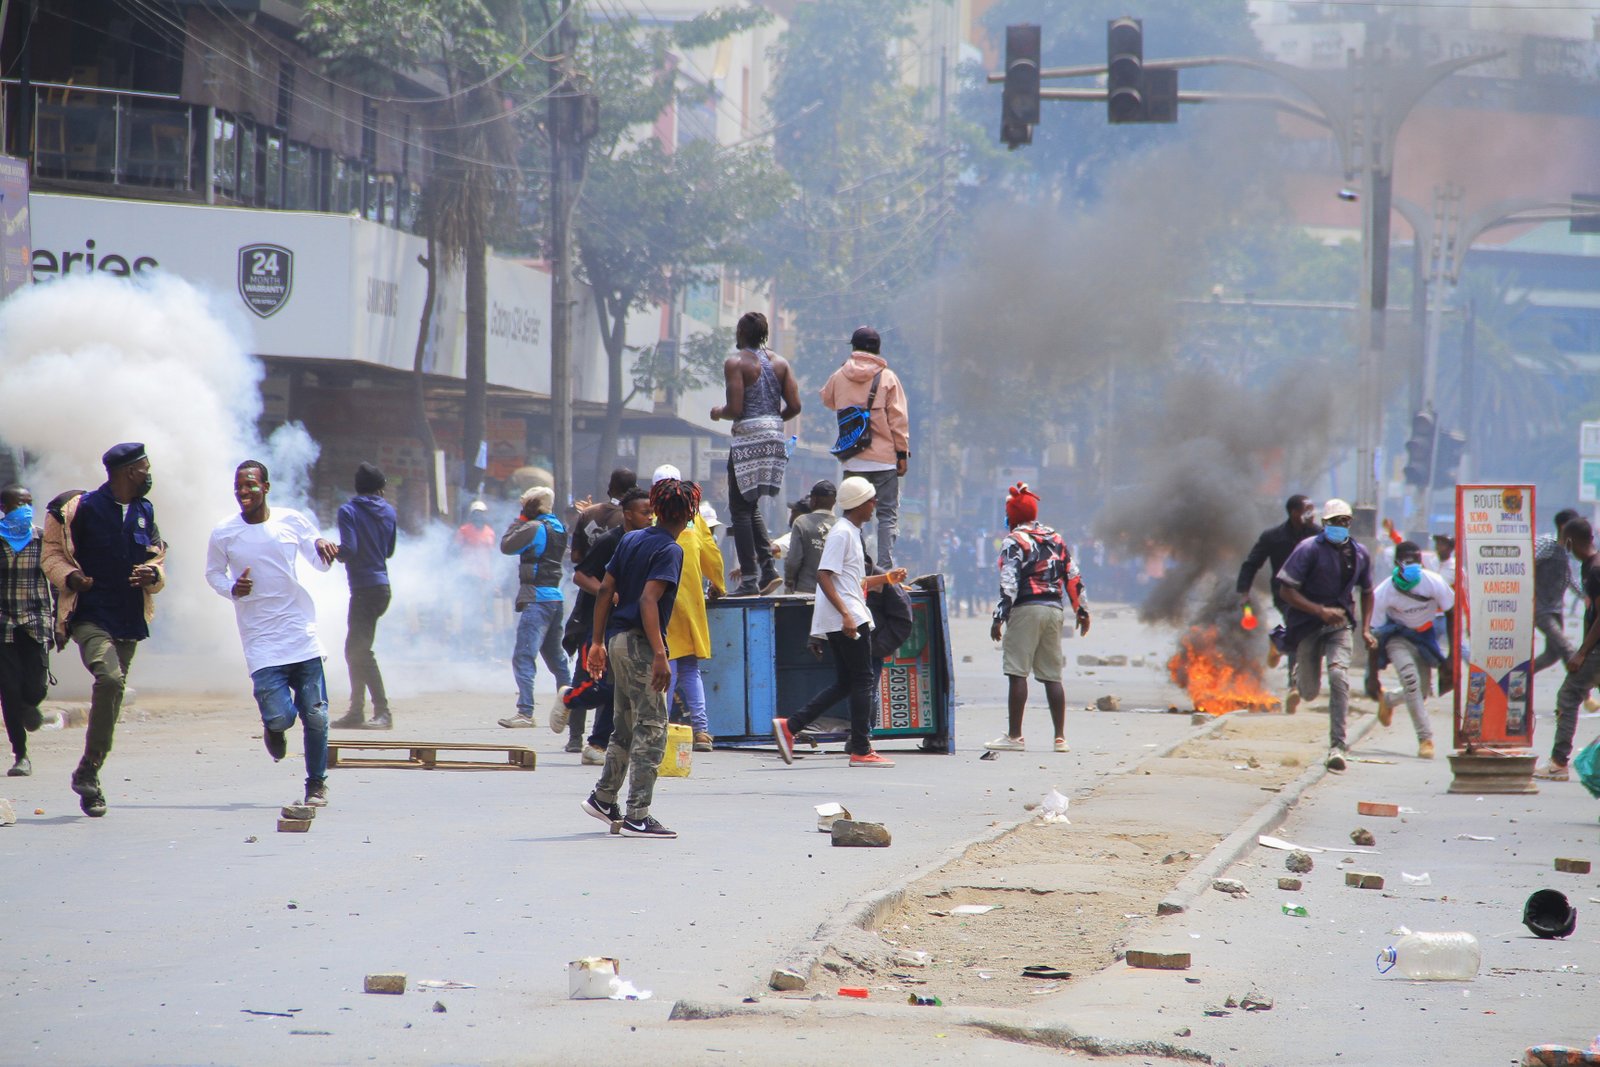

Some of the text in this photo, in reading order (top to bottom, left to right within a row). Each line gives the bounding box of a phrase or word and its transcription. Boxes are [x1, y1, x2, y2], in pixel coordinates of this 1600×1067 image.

[32, 238, 159, 285] eries
[252, 251, 280, 276] 24
[250, 276, 281, 285] MONTH
[245, 284, 286, 294] WARRANTY
[367, 276, 399, 319] SAMSUNG
[1473, 494, 1502, 509] ROUTE
[1467, 523, 1493, 534] SACCO
[1476, 562, 1526, 576] WESTLANDS
[1483, 581, 1520, 595] KANGEMI
[1487, 600, 1518, 613] UTHIRU
[1488, 637, 1514, 650] REGEN
[1486, 655, 1514, 669] KIKUYU
[881, 669, 891, 728] AGENT NAME
[890, 668, 909, 728] 2039603
[909, 672, 918, 722] AGENT NO.
